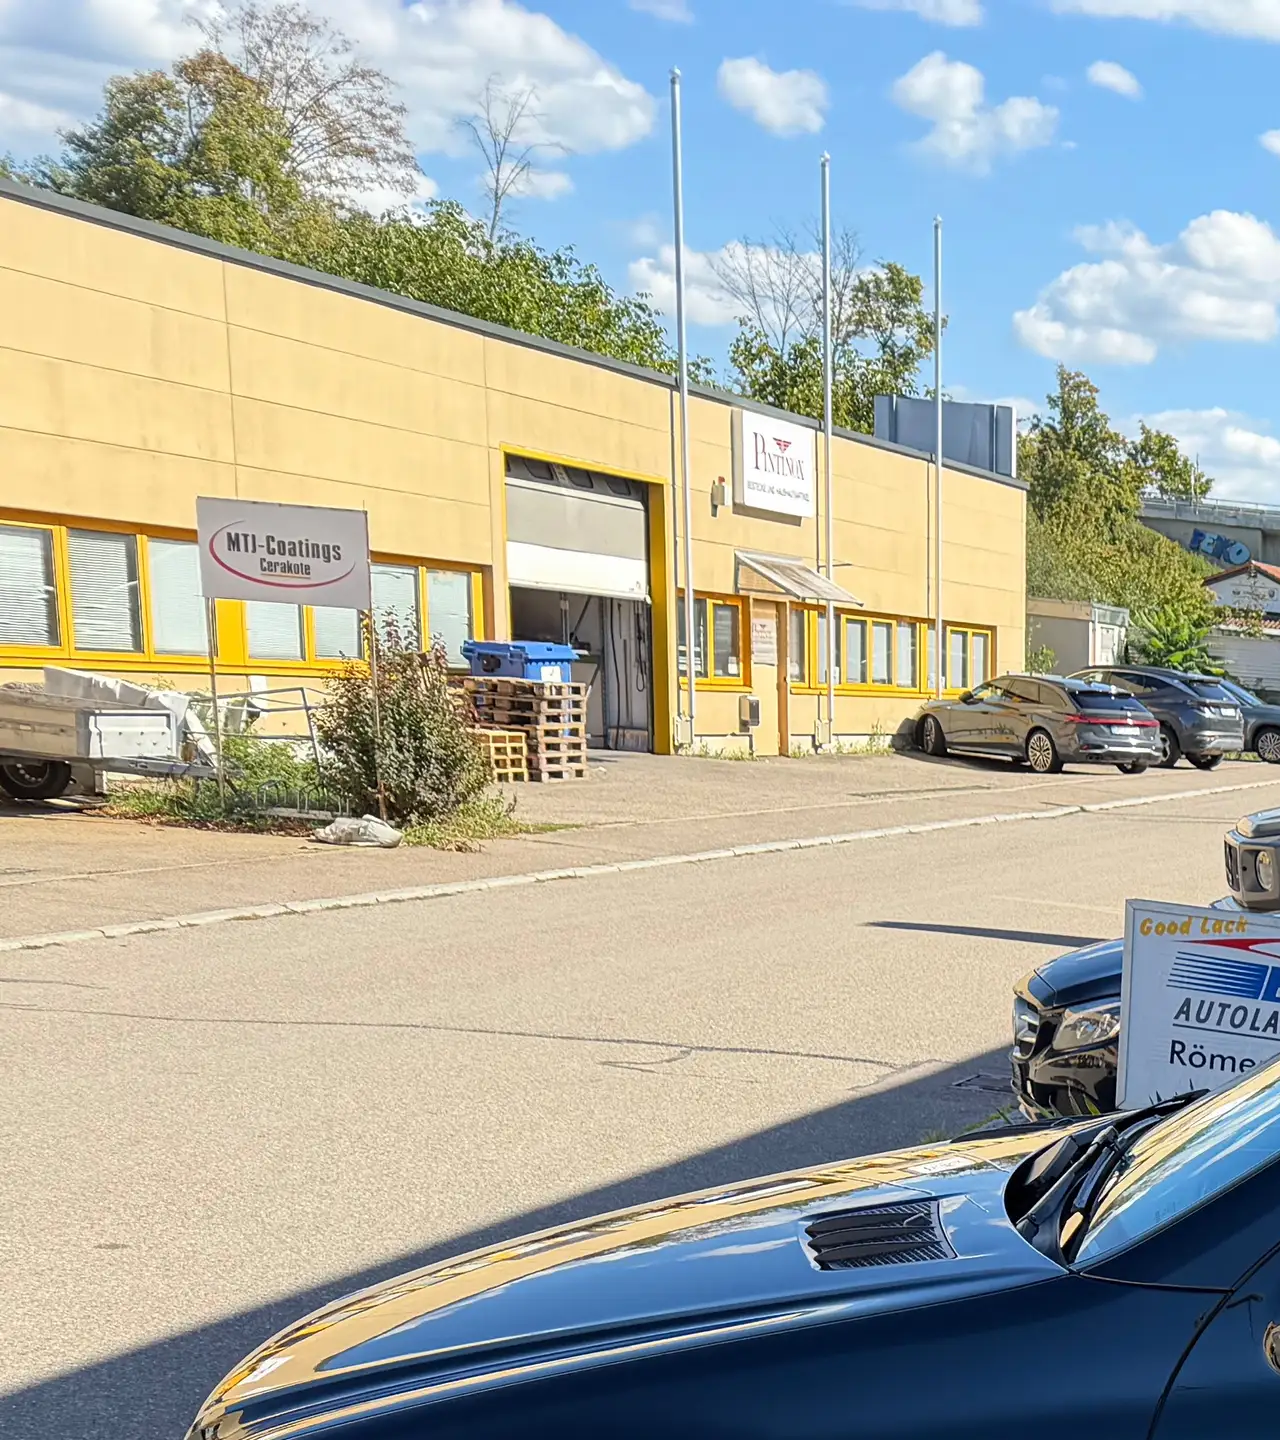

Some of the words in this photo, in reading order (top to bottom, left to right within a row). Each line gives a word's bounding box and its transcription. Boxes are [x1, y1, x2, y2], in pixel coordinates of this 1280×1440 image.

[226, 531, 342, 564] MTJ-Coatings
[259, 557, 311, 576] Cerakote
[1139, 915, 1193, 936] Good
[1169, 1040, 1260, 1074] Röme
